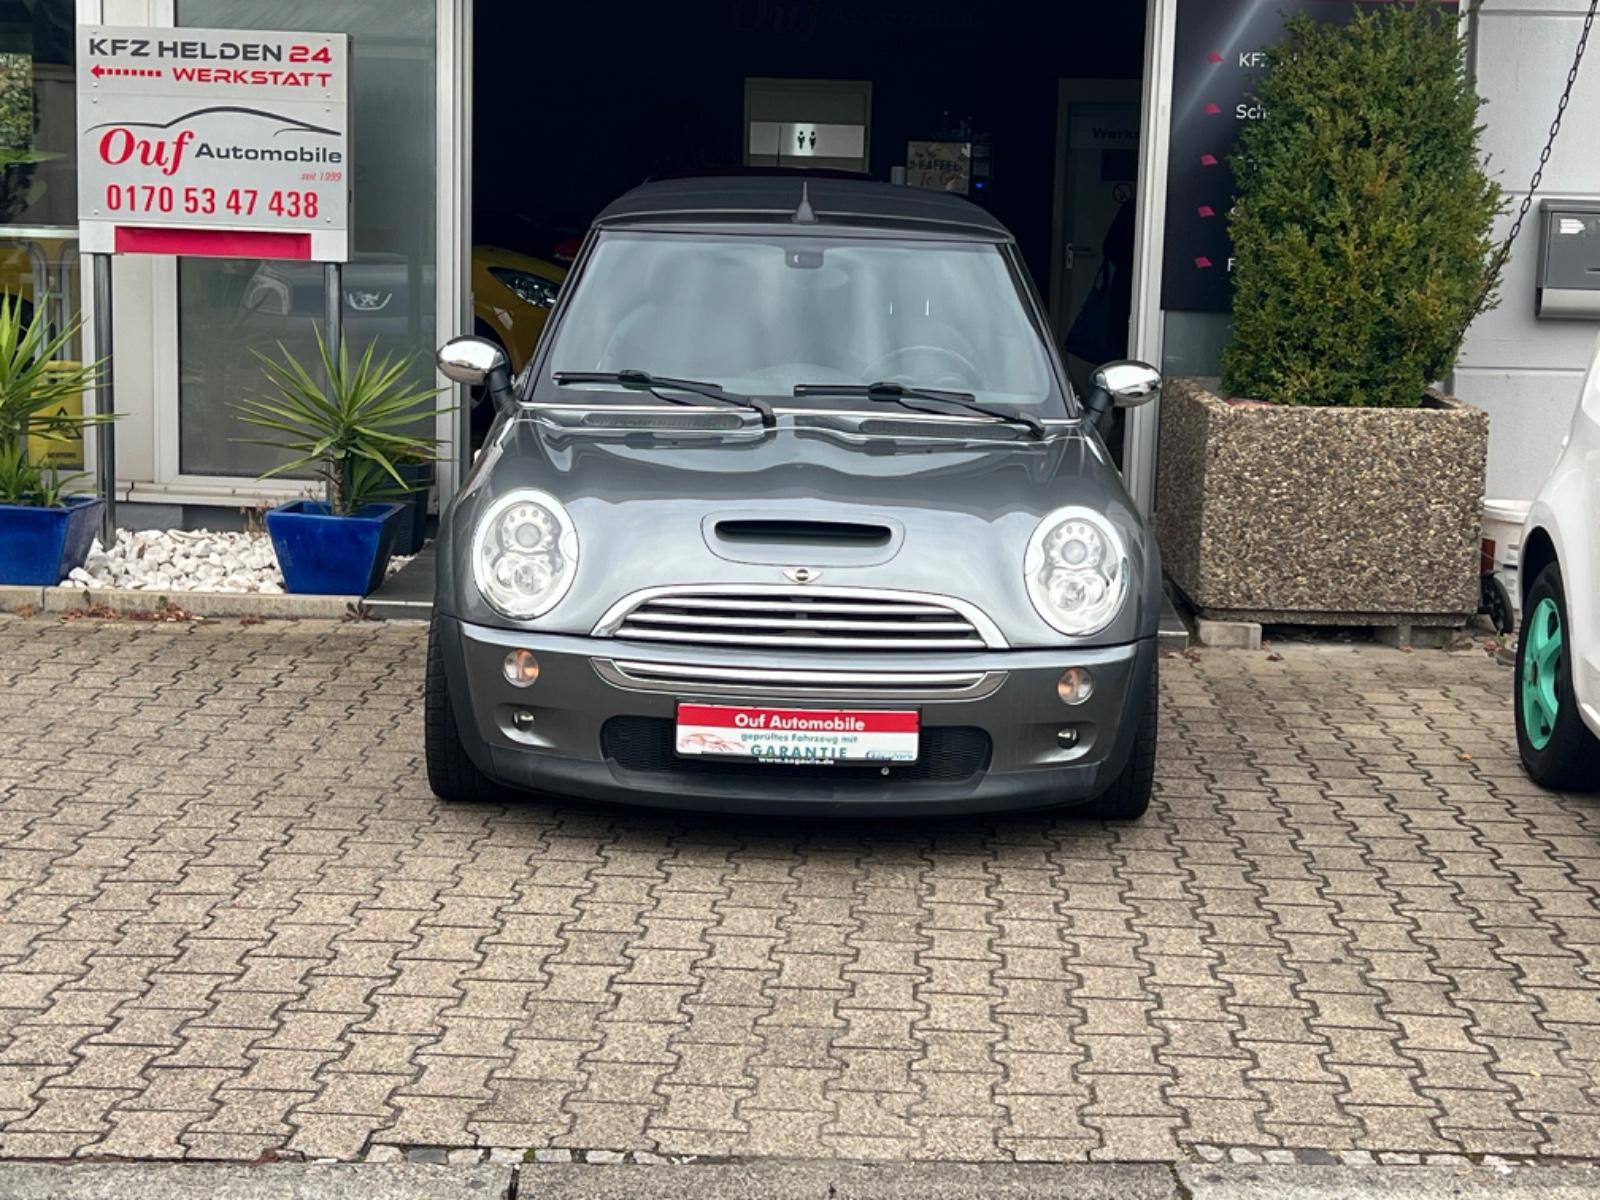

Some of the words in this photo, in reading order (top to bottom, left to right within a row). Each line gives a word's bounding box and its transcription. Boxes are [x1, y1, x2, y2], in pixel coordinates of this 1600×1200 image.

[89, 38, 150, 58] KFZ
[158, 40, 283, 62] HELDEN
[288, 46, 332, 64] 24
[172, 67, 332, 88] WERKSTATT
[99, 127, 194, 177] Ouf
[195, 142, 342, 164] Automobile
[106, 184, 174, 213] 0170
[184, 187, 216, 214] 53
[226, 188, 259, 216] 47
[268, 190, 318, 219] 438
[734, 713, 766, 728] Ouf
[769, 714, 865, 731] Automobile
[740, 732, 790, 743] geprüftes
[791, 732, 839, 745] Fahrzeug
[840, 734, 858, 744] mit
[750, 743, 847, 759] GARANTIE
